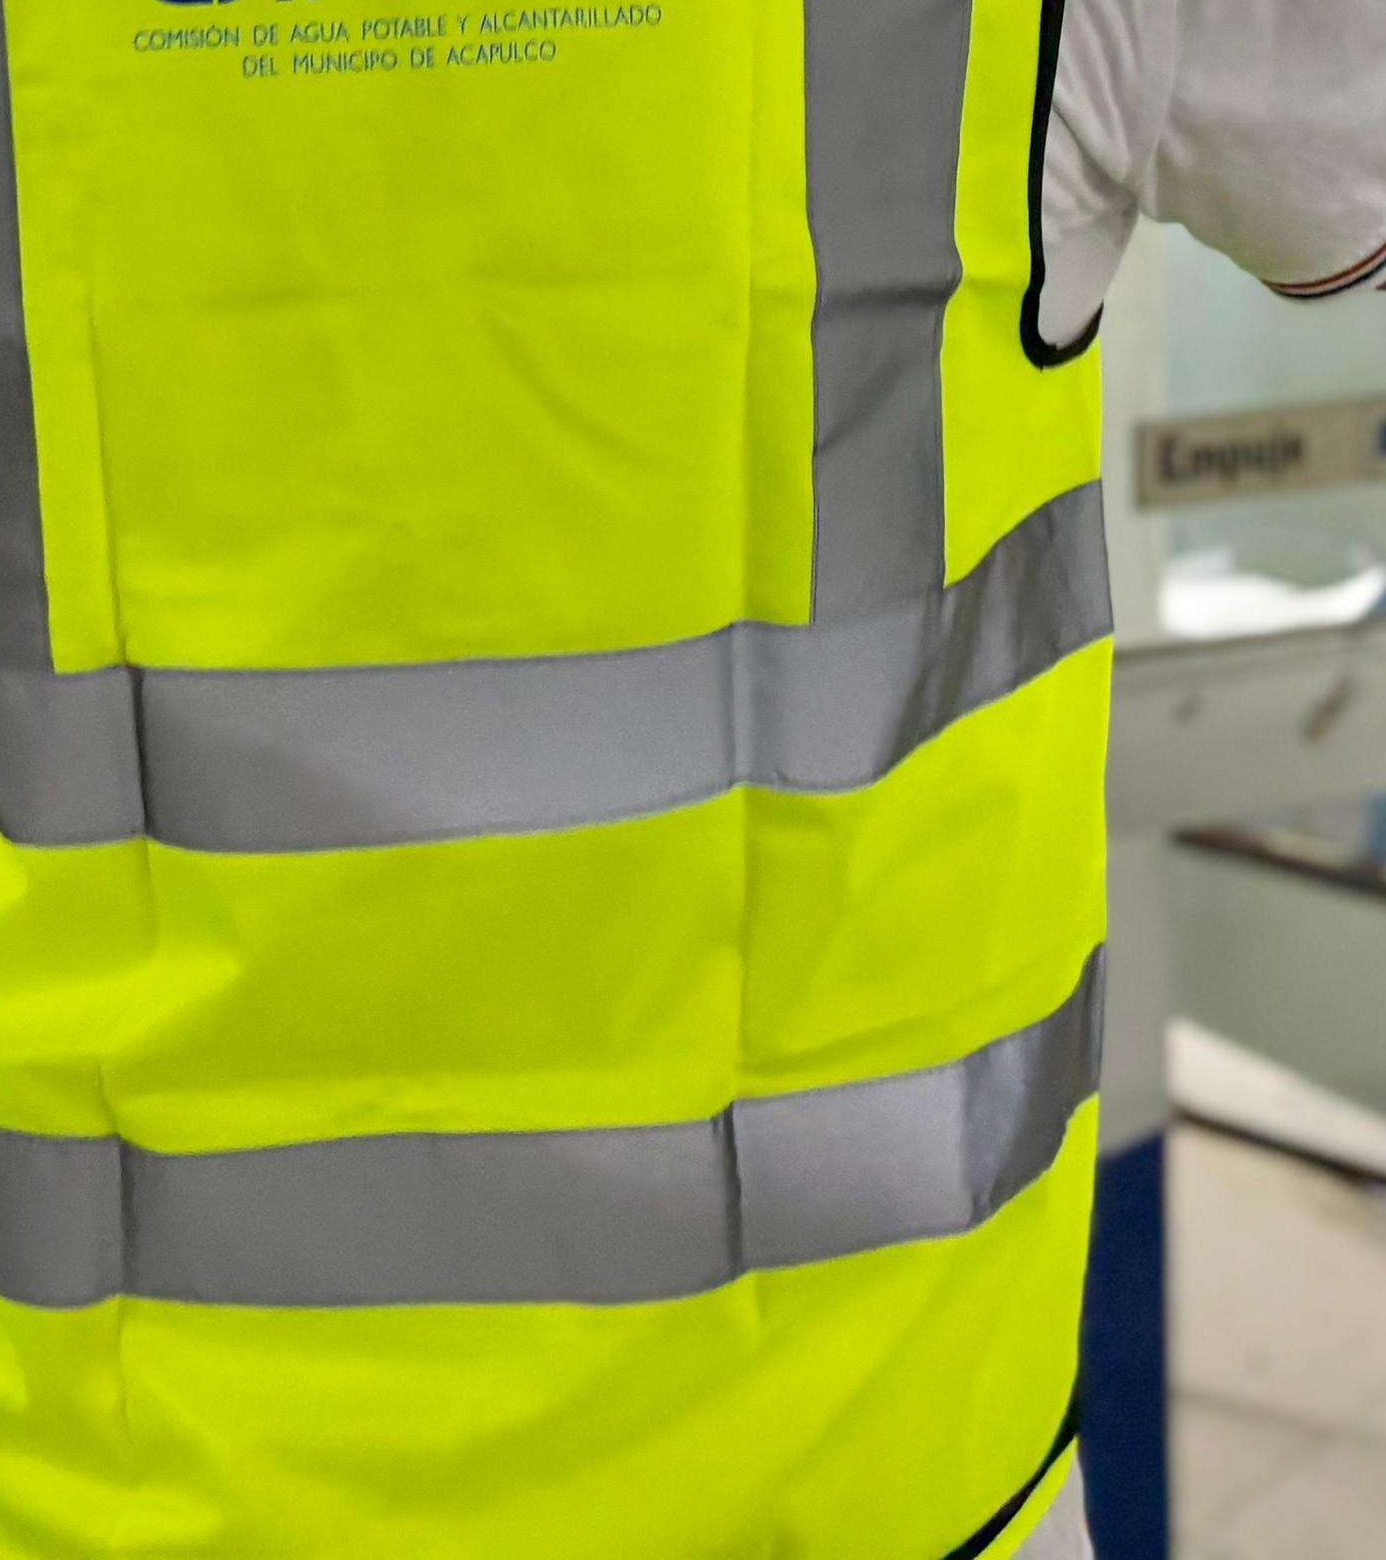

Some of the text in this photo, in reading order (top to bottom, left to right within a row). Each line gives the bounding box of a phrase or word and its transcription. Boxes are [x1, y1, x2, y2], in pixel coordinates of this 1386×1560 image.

[133, 3, 662, 52] COMISIÓN DE AGUA POTABLE Y ALCANTARILLADO
[242, 53, 278, 77] DEL
[410, 46, 435, 69] DE
[446, 39, 557, 66] ACAPULCO
